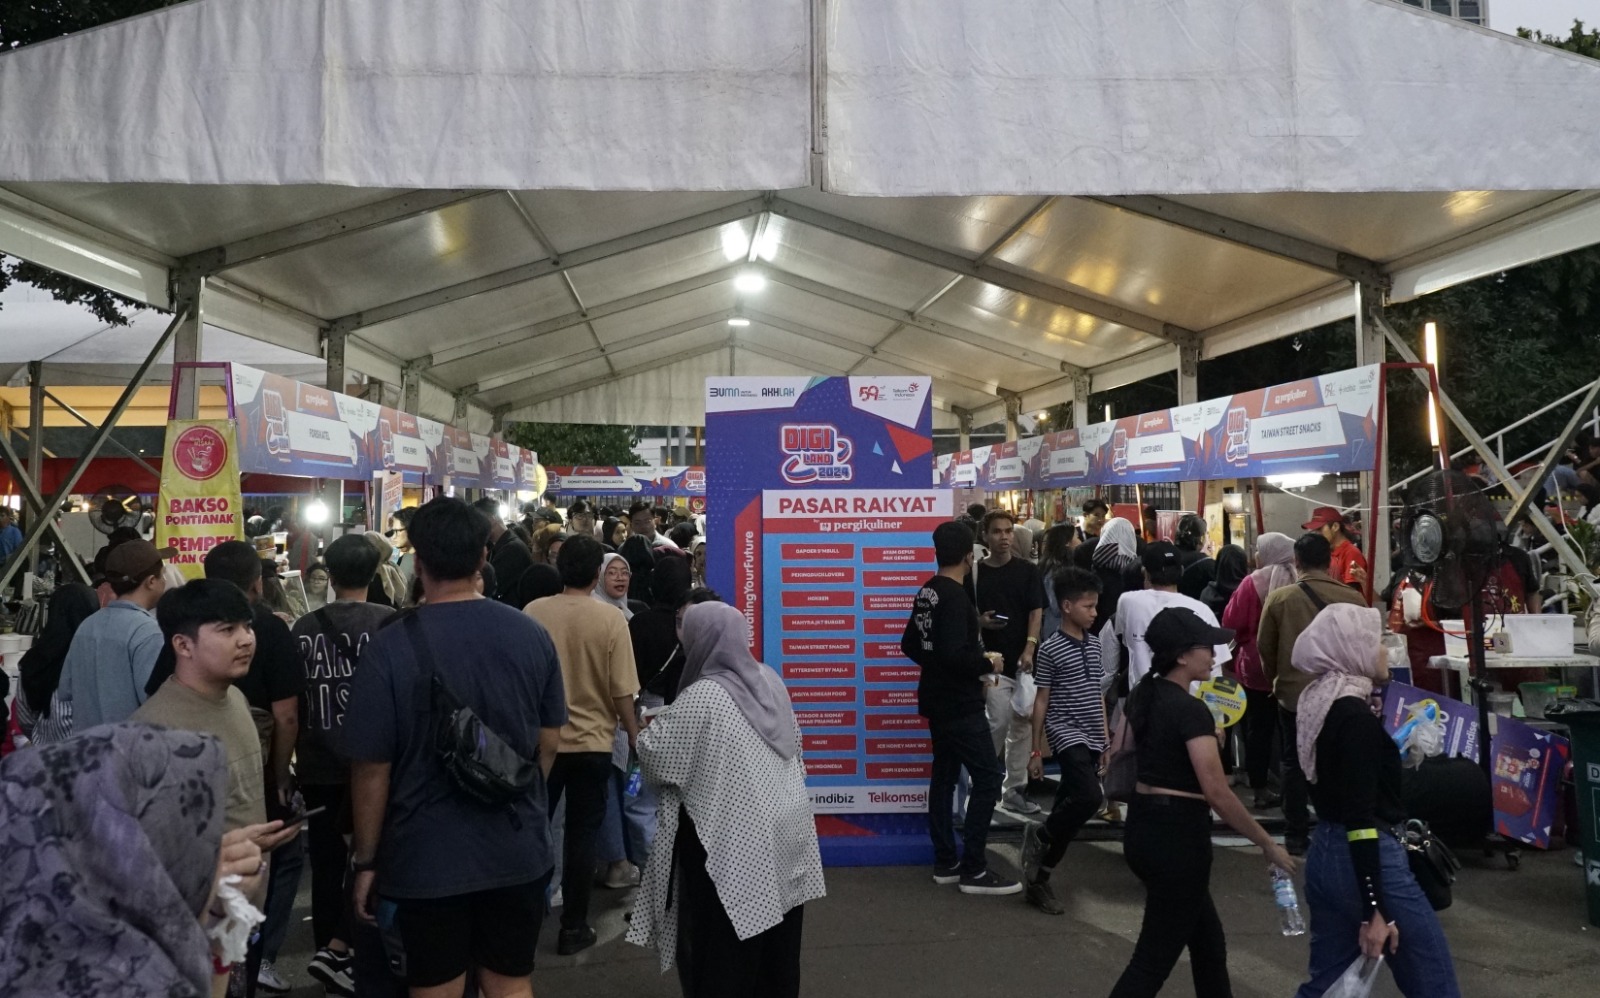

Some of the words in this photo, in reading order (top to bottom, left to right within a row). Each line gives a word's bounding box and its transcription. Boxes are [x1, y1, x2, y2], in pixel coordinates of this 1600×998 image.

[762, 388, 795, 397] AKHLAK
[1261, 428, 1279, 439] TAIWAN
[1280, 425, 1298, 437] STREET
[1299, 422, 1321, 434] SNACKS
[784, 428, 834, 451] DIGI
[803, 454, 833, 465] LAND
[818, 467, 849, 478] 2024
[171, 498, 228, 513] BAKSO
[779, 498, 848, 514] PASAR
[853, 497, 936, 513] RAKYAT
[166, 514, 234, 525] PONTIANAK
[834, 519, 903, 532] pergikuliner
[815, 793, 854, 804] indibiz
[868, 791, 927, 803] Telkomsel
